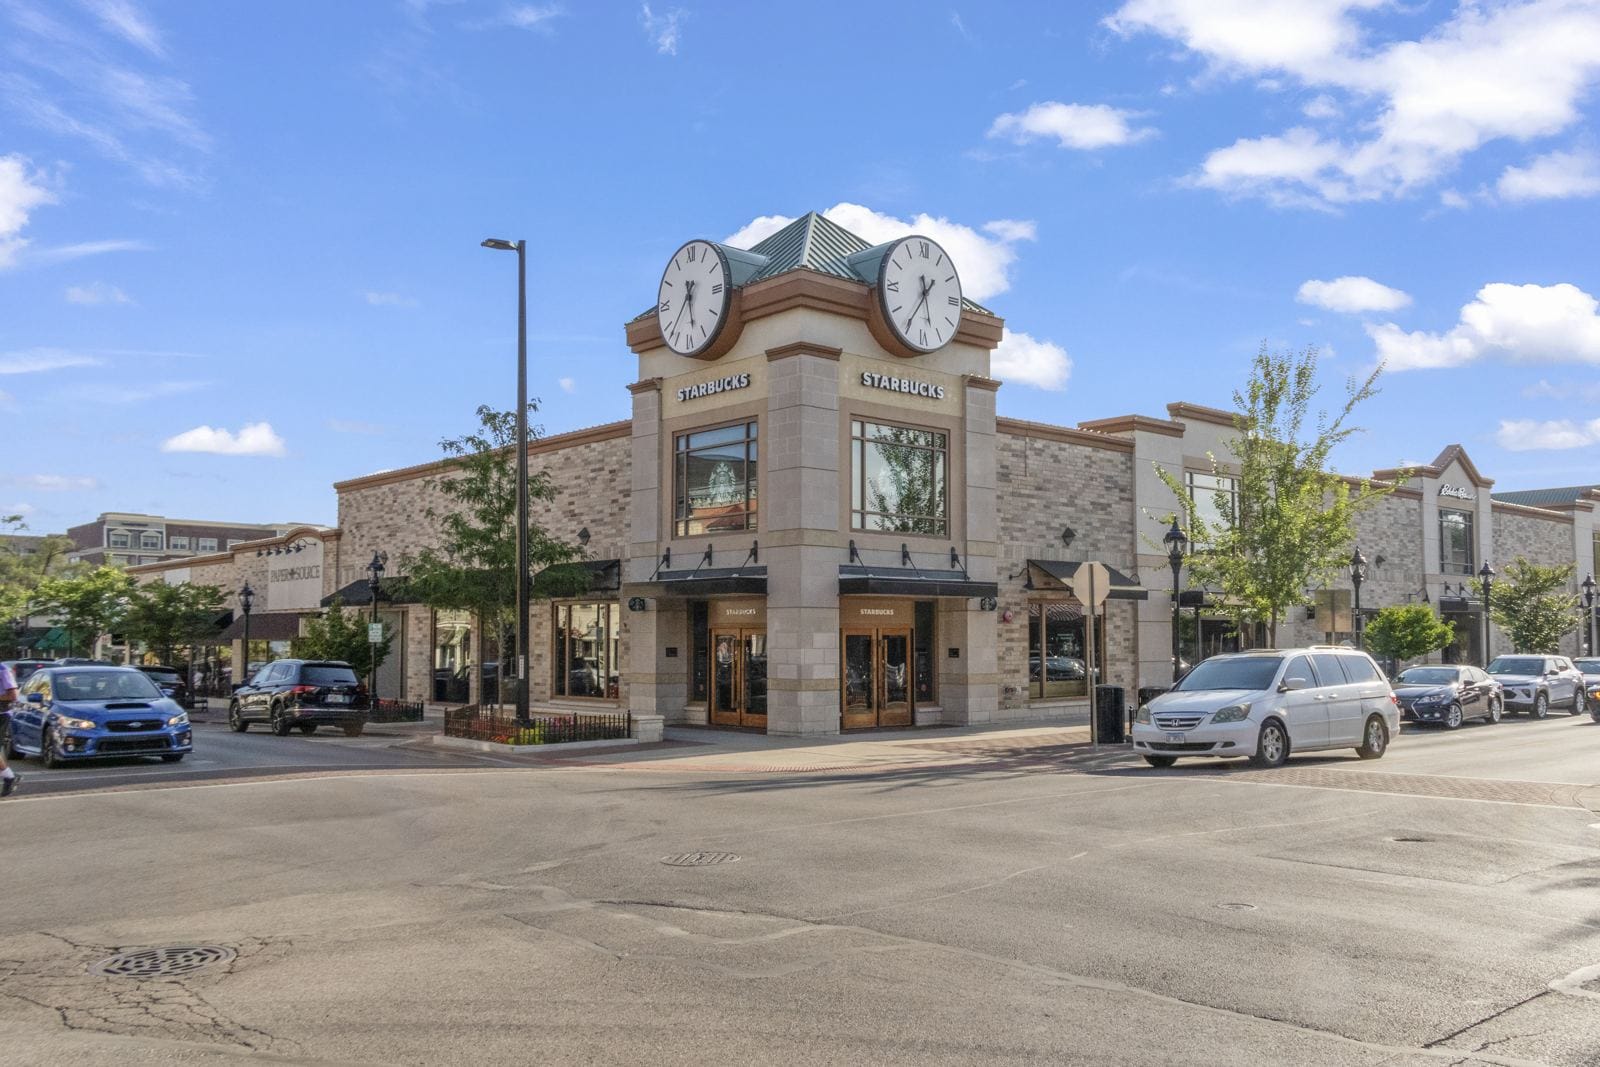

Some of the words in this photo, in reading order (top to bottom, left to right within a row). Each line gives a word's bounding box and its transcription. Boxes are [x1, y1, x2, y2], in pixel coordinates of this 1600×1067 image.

[677, 373, 750, 402] STARBUCKS
[861, 371, 945, 400] STARBUCKS
[296, 565, 320, 580] SOURCE
[726, 608, 756, 616] STARBUCKS
